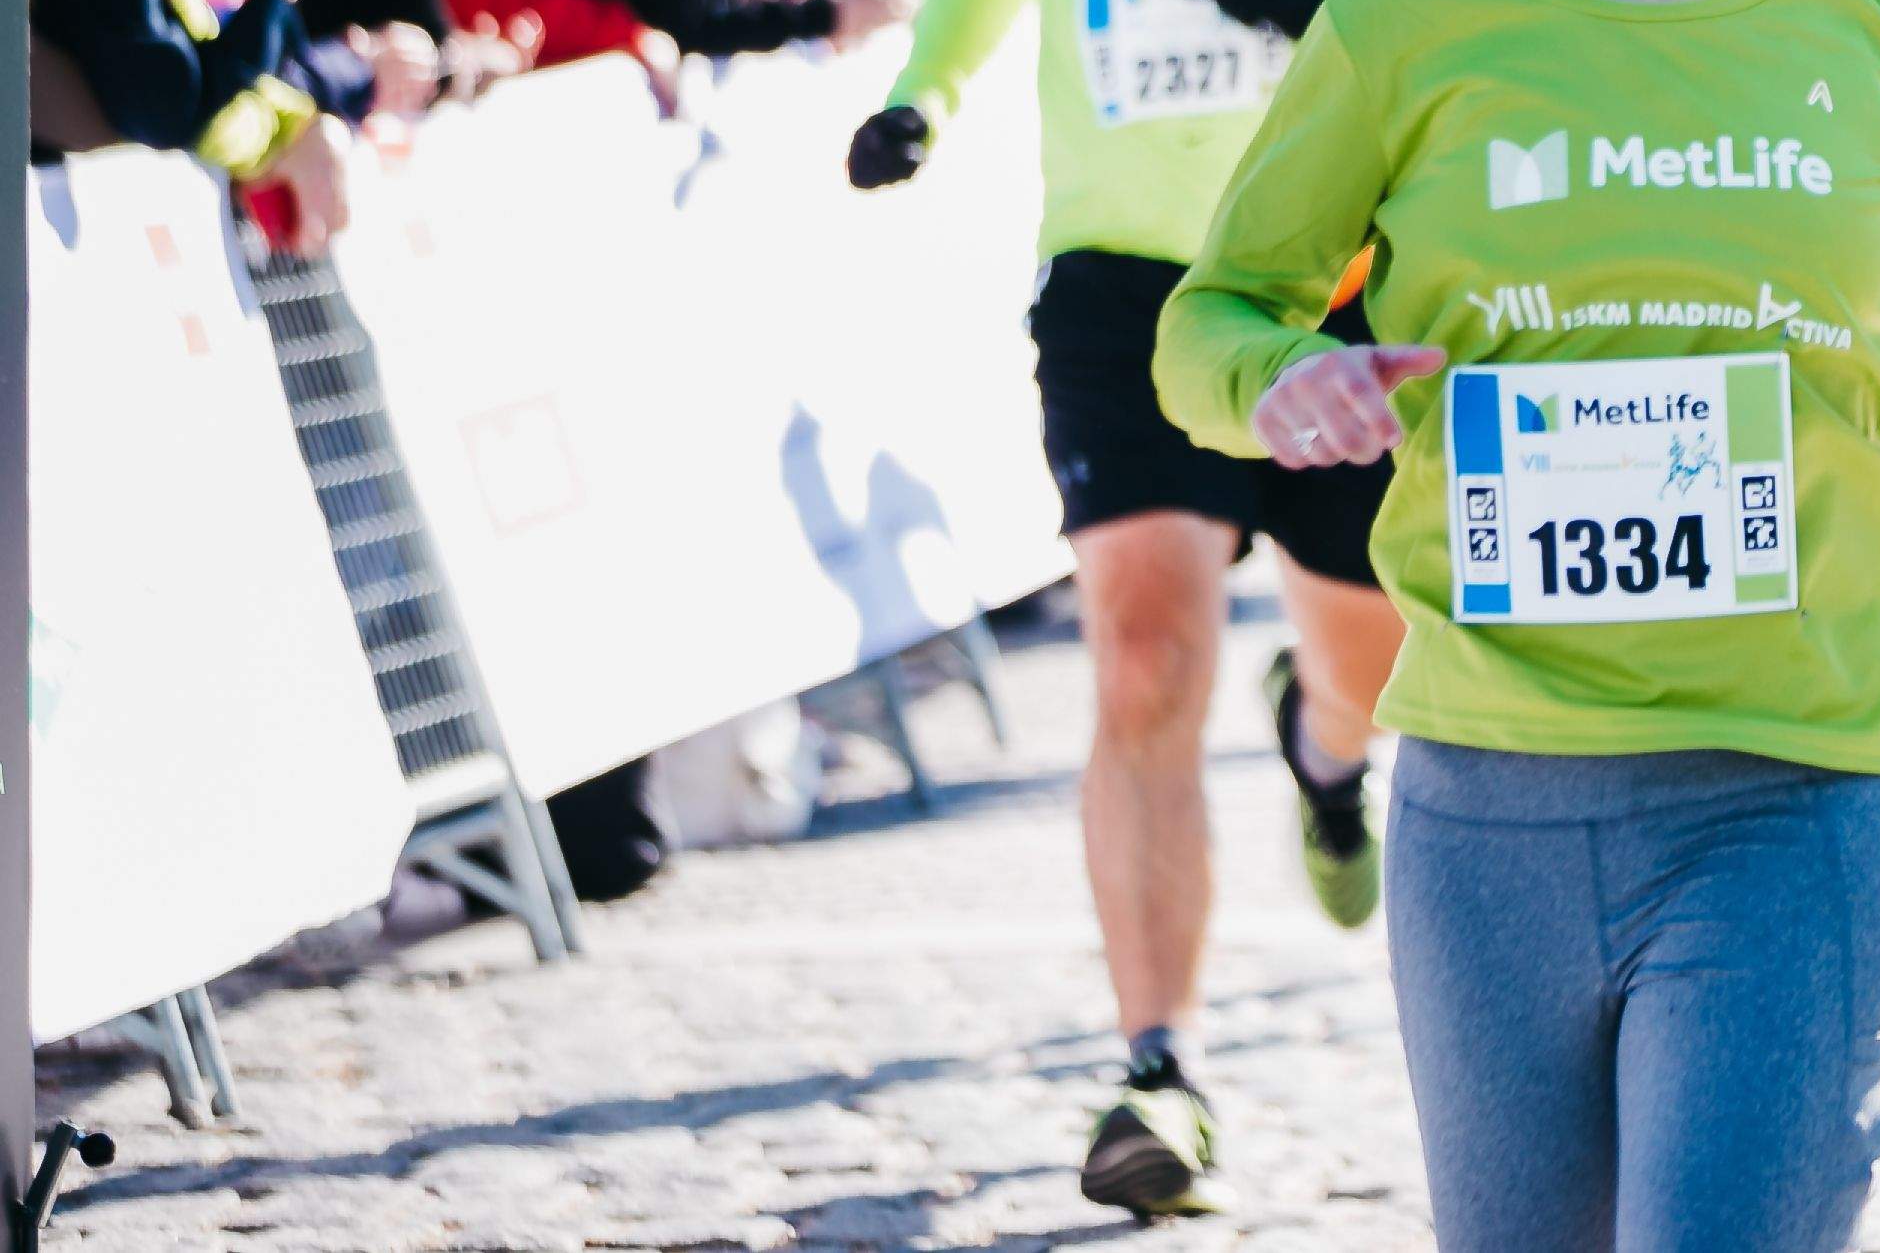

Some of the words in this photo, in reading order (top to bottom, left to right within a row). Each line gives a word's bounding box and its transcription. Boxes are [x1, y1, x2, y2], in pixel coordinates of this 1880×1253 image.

[1590, 135, 1834, 195] MetLife
[1467, 282, 1554, 338] VIII
[1561, 301, 1631, 331] 15KM
[1639, 301, 1752, 330] MADRID
[1573, 393, 1711, 427] MetLife
[1528, 515, 1711, 597] 1334
